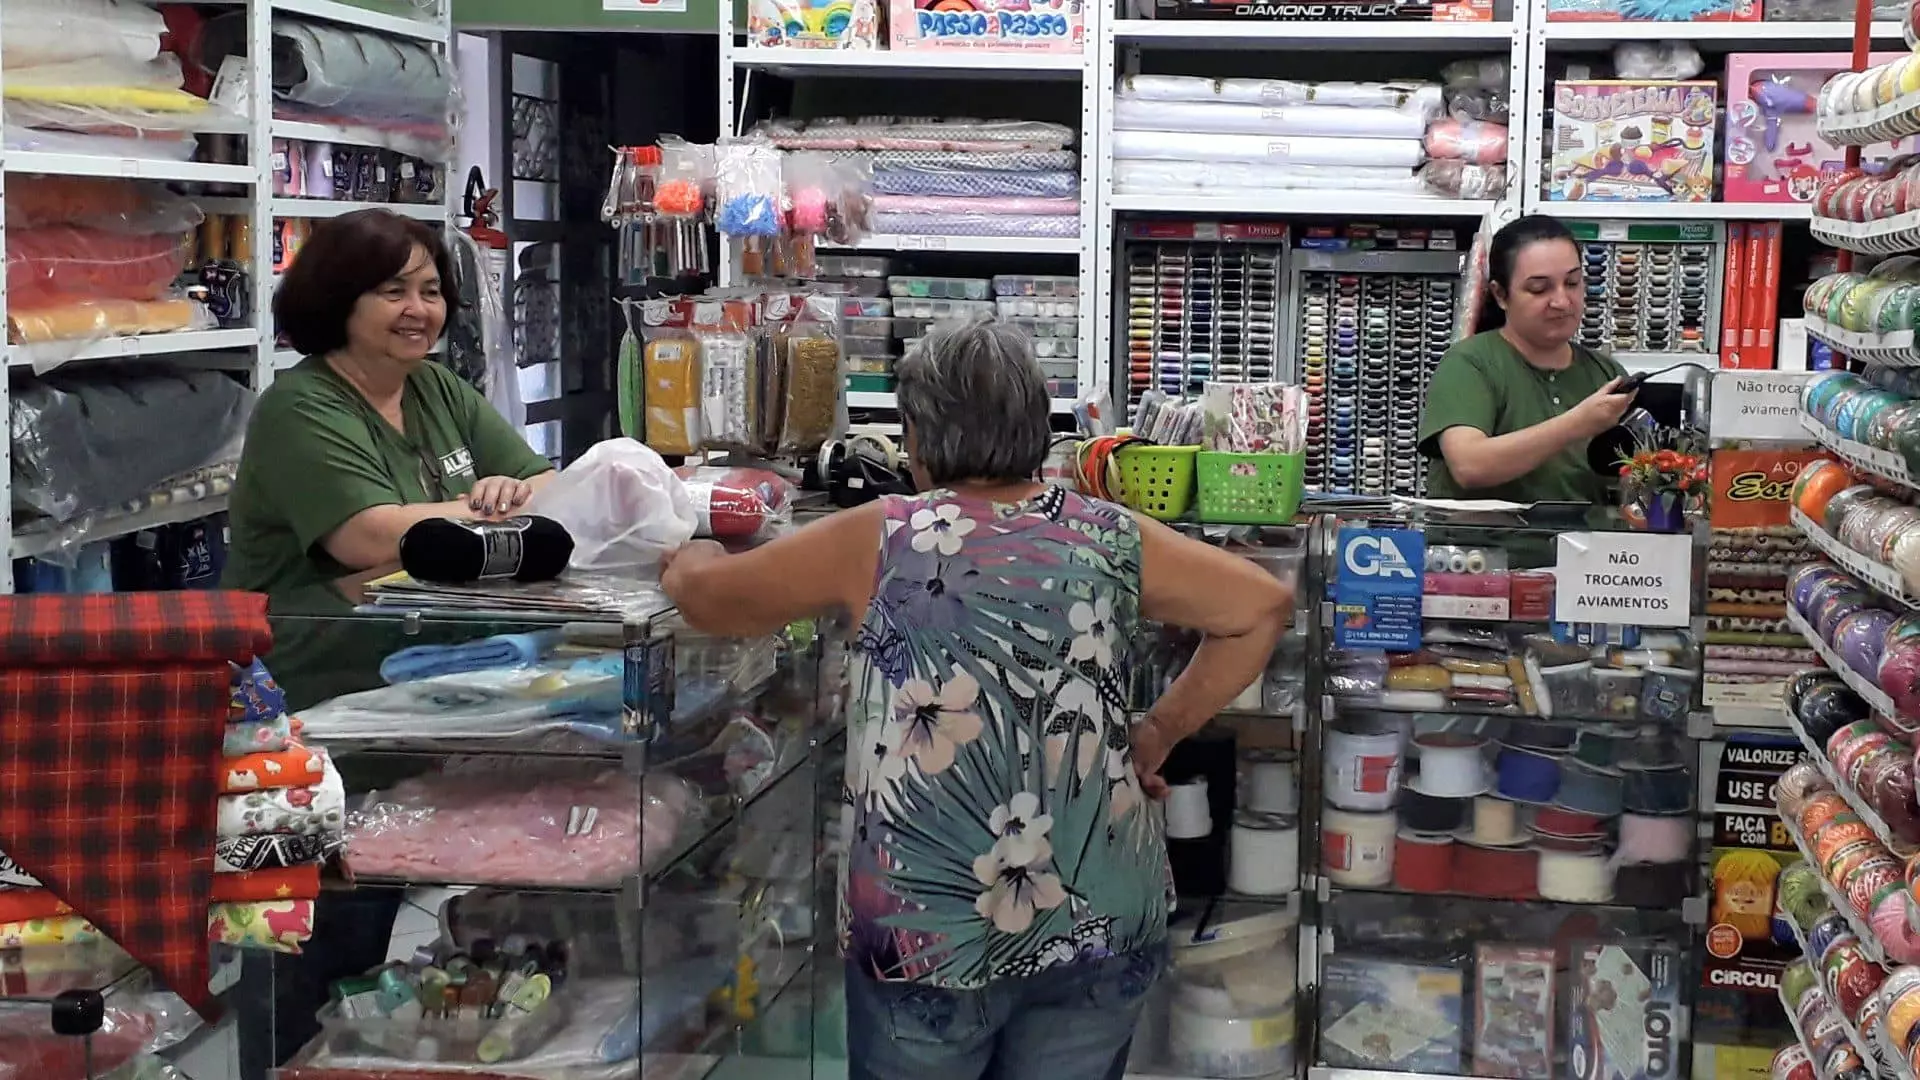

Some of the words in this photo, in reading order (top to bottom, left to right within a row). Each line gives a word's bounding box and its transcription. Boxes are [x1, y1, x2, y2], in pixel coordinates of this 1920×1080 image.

[1235, 4, 1326, 16] DIAMOND
[1331, 4, 1399, 16] TRUCK
[1736, 380, 1764, 393] Não
[1741, 405, 1798, 416] aviamen
[1727, 471, 1794, 501] Est
[1608, 550, 1641, 566] NÃO
[1584, 573, 1664, 588] TROCAMOS
[1576, 594, 1669, 610] AVIAMENTOS
[1726, 748, 1796, 765] VALORIZE
[1727, 780, 1765, 800] USE
[1724, 815, 1767, 833] FAÇA
[1740, 832, 1767, 844] COM
[1771, 821, 1792, 845] B
